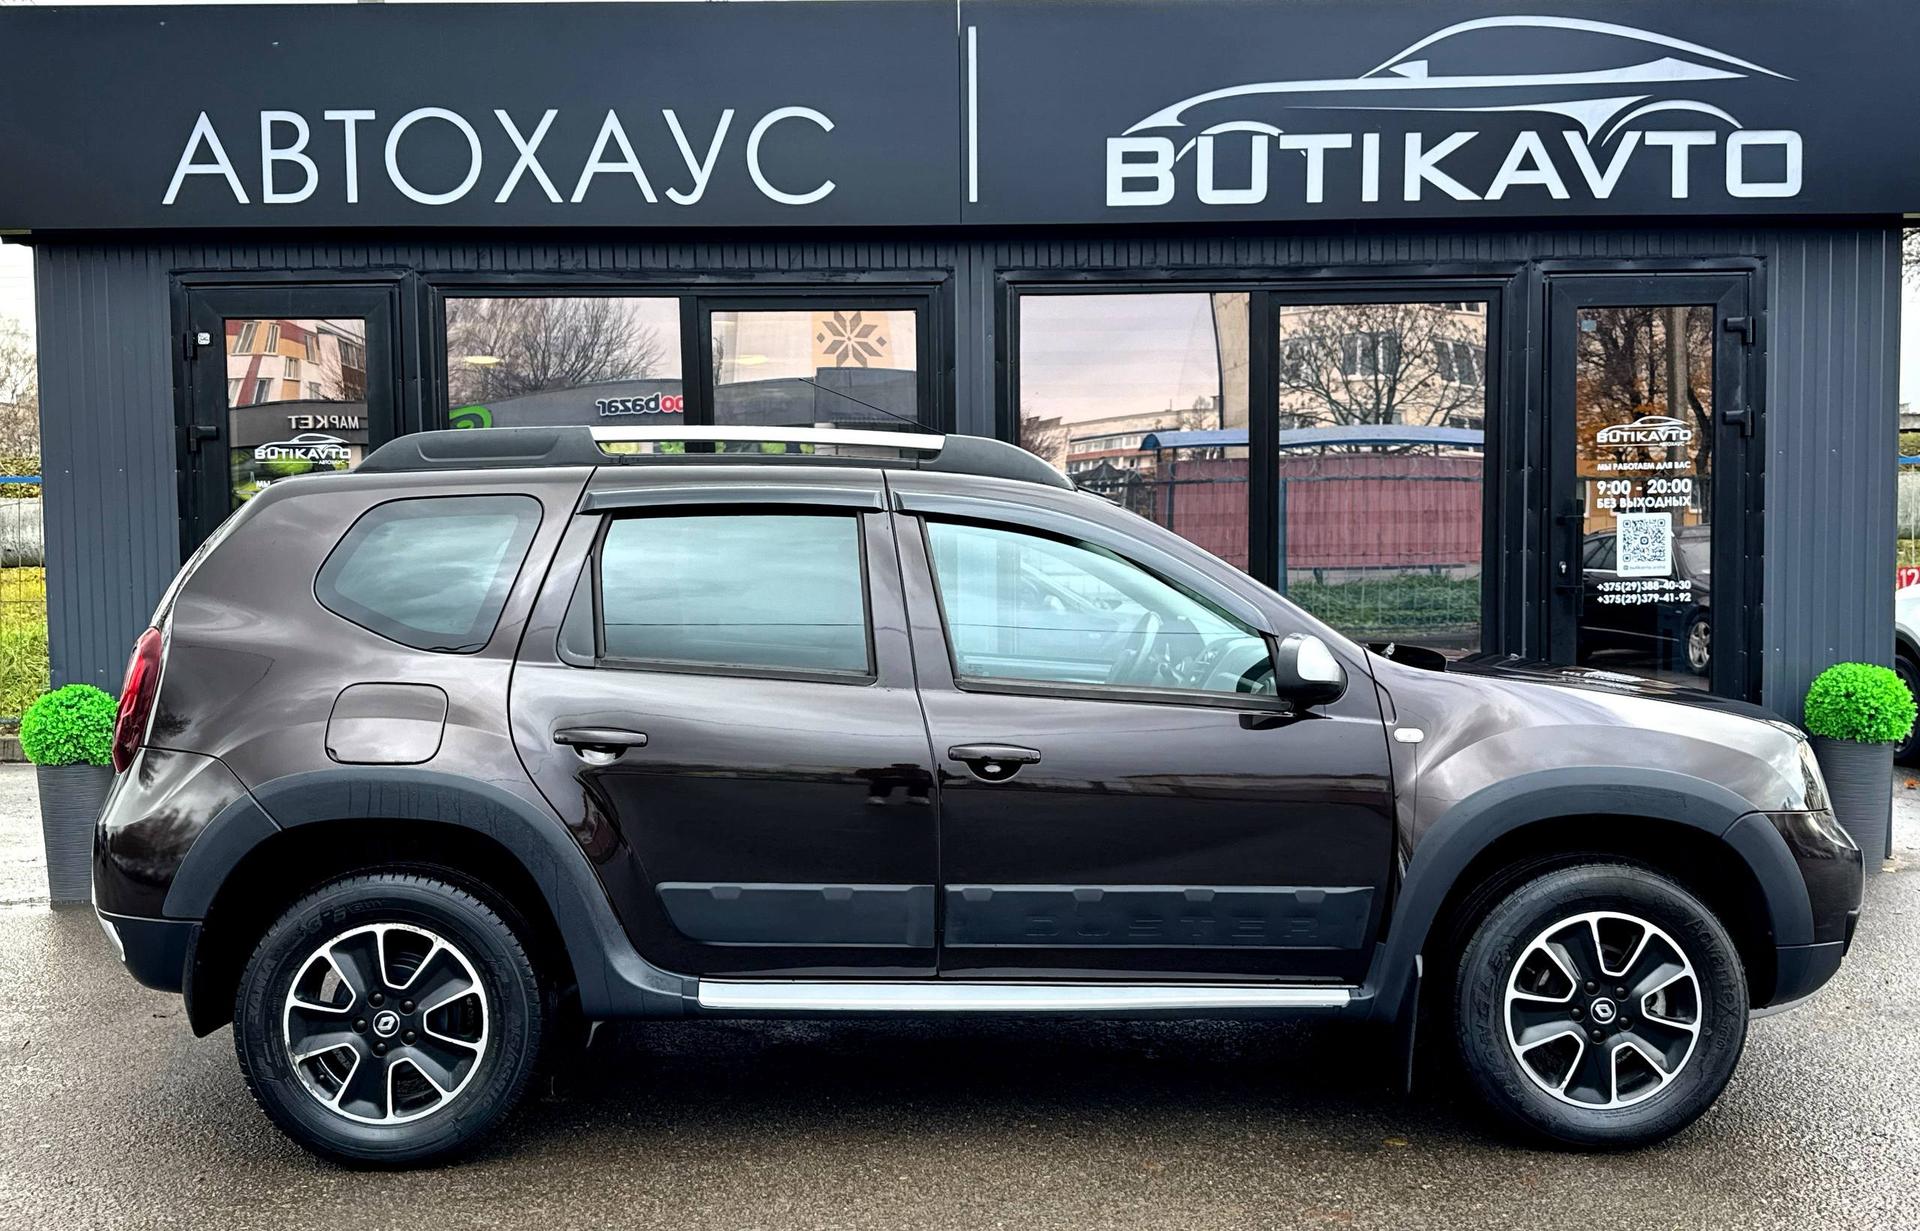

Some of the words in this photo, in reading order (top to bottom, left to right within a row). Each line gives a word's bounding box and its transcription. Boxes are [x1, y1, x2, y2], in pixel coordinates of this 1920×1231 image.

[162, 106, 836, 205] АВТОХАУС
[1106, 129, 1803, 207] BUTIKAVTO
[1596, 430, 1692, 442] BUTIKAVTO
[254, 448, 352, 460] BUTIKAVTO
[1613, 462, 1655, 471] РАБОТАЕМ
[1656, 462, 1673, 470] ДЛЯ
[1674, 461, 1692, 470] ВАС
[1597, 480, 1631, 495] 9:00
[1647, 478, 1692, 494] 20:00
[1597, 498, 1617, 509] БЕЗ
[1619, 496, 1691, 508] ВЫХОДНЫХ
[1597, 580, 1692, 593] +375(29)388-40-30
[1597, 592, 1692, 605] +375(29)379-41-92
[1024, 914, 1320, 938] DUSTER
